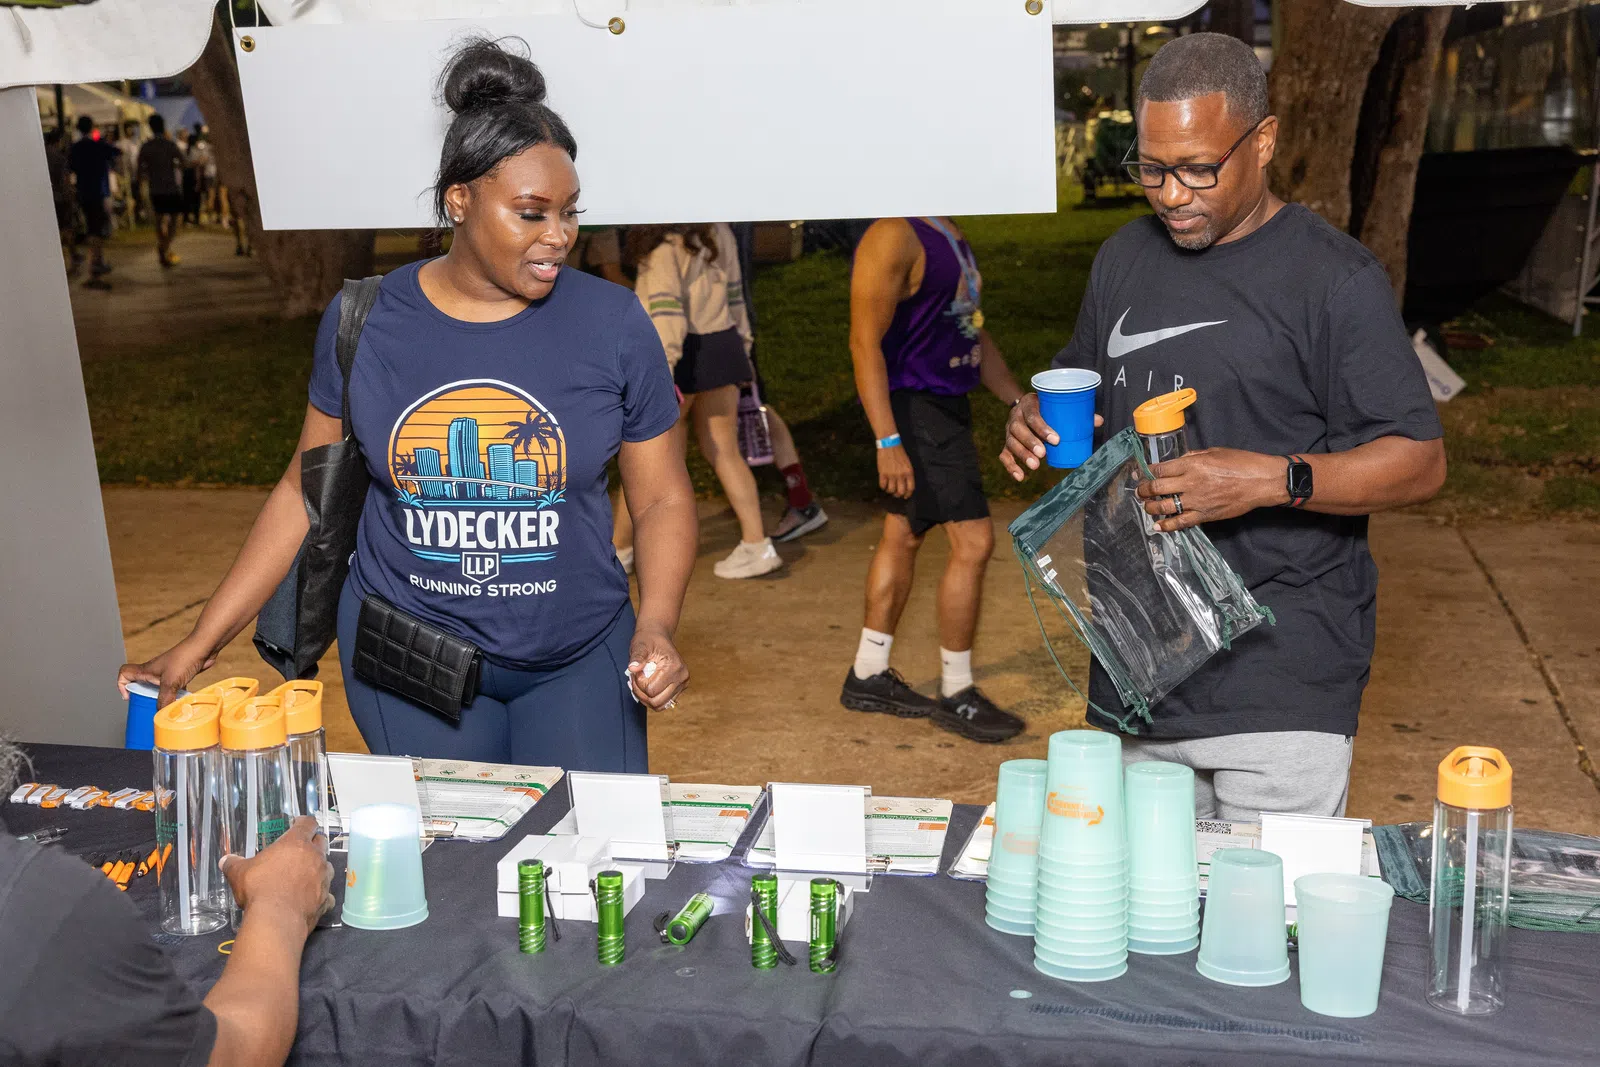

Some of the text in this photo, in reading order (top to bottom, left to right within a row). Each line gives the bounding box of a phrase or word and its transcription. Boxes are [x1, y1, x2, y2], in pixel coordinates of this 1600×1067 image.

[1113, 365, 1184, 392] AIR
[403, 508, 560, 550] LYDECKER
[466, 556, 495, 576] LLP
[409, 574, 557, 597] RUNNING STRONG
